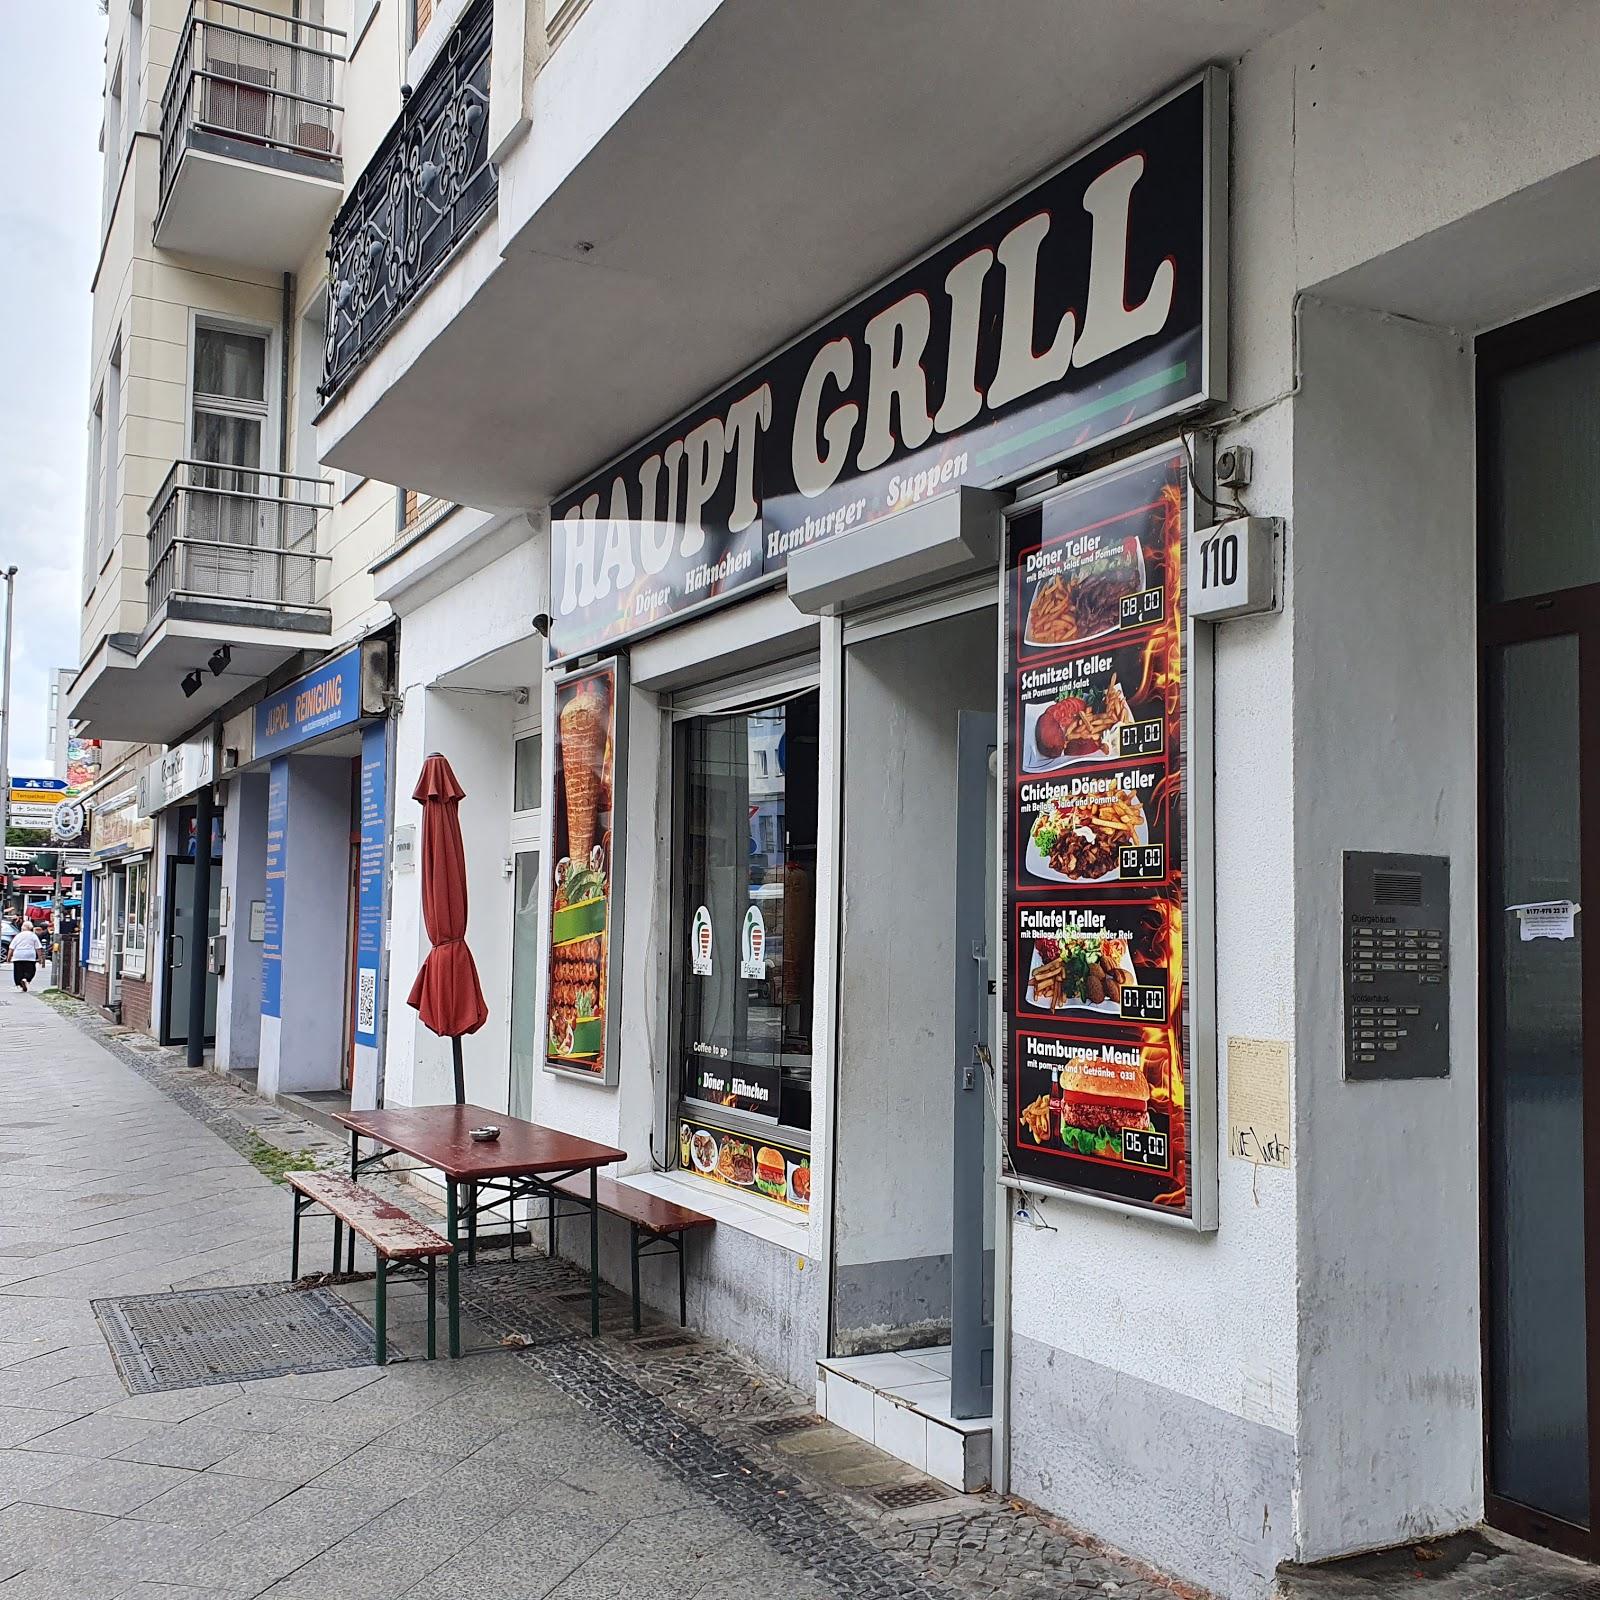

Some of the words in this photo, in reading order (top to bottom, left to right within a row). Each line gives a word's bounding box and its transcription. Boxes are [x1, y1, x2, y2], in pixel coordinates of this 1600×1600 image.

[560, 382, 772, 615] HAUPT
[792, 154, 1174, 498] GRILL
[635, 585, 670, 616] Döner
[685, 549, 752, 595] Hähnchen
[767, 497, 866, 558] Hamburger
[886, 451, 968, 506] Suppen
[1026, 549, 1063, 573] Döner
[1065, 535, 1101, 558] Teller
[1026, 573, 1037, 583] mit
[1063, 560, 1080, 571] Salat
[1080, 552, 1094, 565] und
[1095, 545, 1124, 561] Pommes
[1200, 534, 1238, 589] 110
[1021, 661, 1073, 690] Schnitzel
[1076, 655, 1113, 677] Teller
[295, 674, 342, 724] REINIGUNG
[1021, 691, 1032, 701] mit
[1032, 686, 1058, 699] Pommes
[1059, 681, 1072, 691] und
[1073, 678, 1090, 689] Salat
[1021, 784, 1069, 802] Chicken
[1072, 776, 1111, 796] Döner
[1115, 771, 1155, 790] Teller
[1020, 803, 1031, 813] mit
[1075, 796, 1088, 806] und
[1089, 795, 1119, 805] Pommes
[1020, 909, 1066, 928] Fallafel
[1069, 909, 1106, 928] Teller
[1020, 930, 1031, 939] mit
[1118, 930, 1134, 939] Reis
[693, 1042, 712, 1053] Coffee
[712, 1045, 719, 1054] to
[720, 1047, 728, 1057] go
[1027, 1037, 1098, 1062] Hamburger
[1102, 1045, 1140, 1067] Menü
[1027, 1059, 1037, 1068] mit
[703, 1072, 724, 1091] Döner
[732, 1078, 769, 1101] Hähnchen
